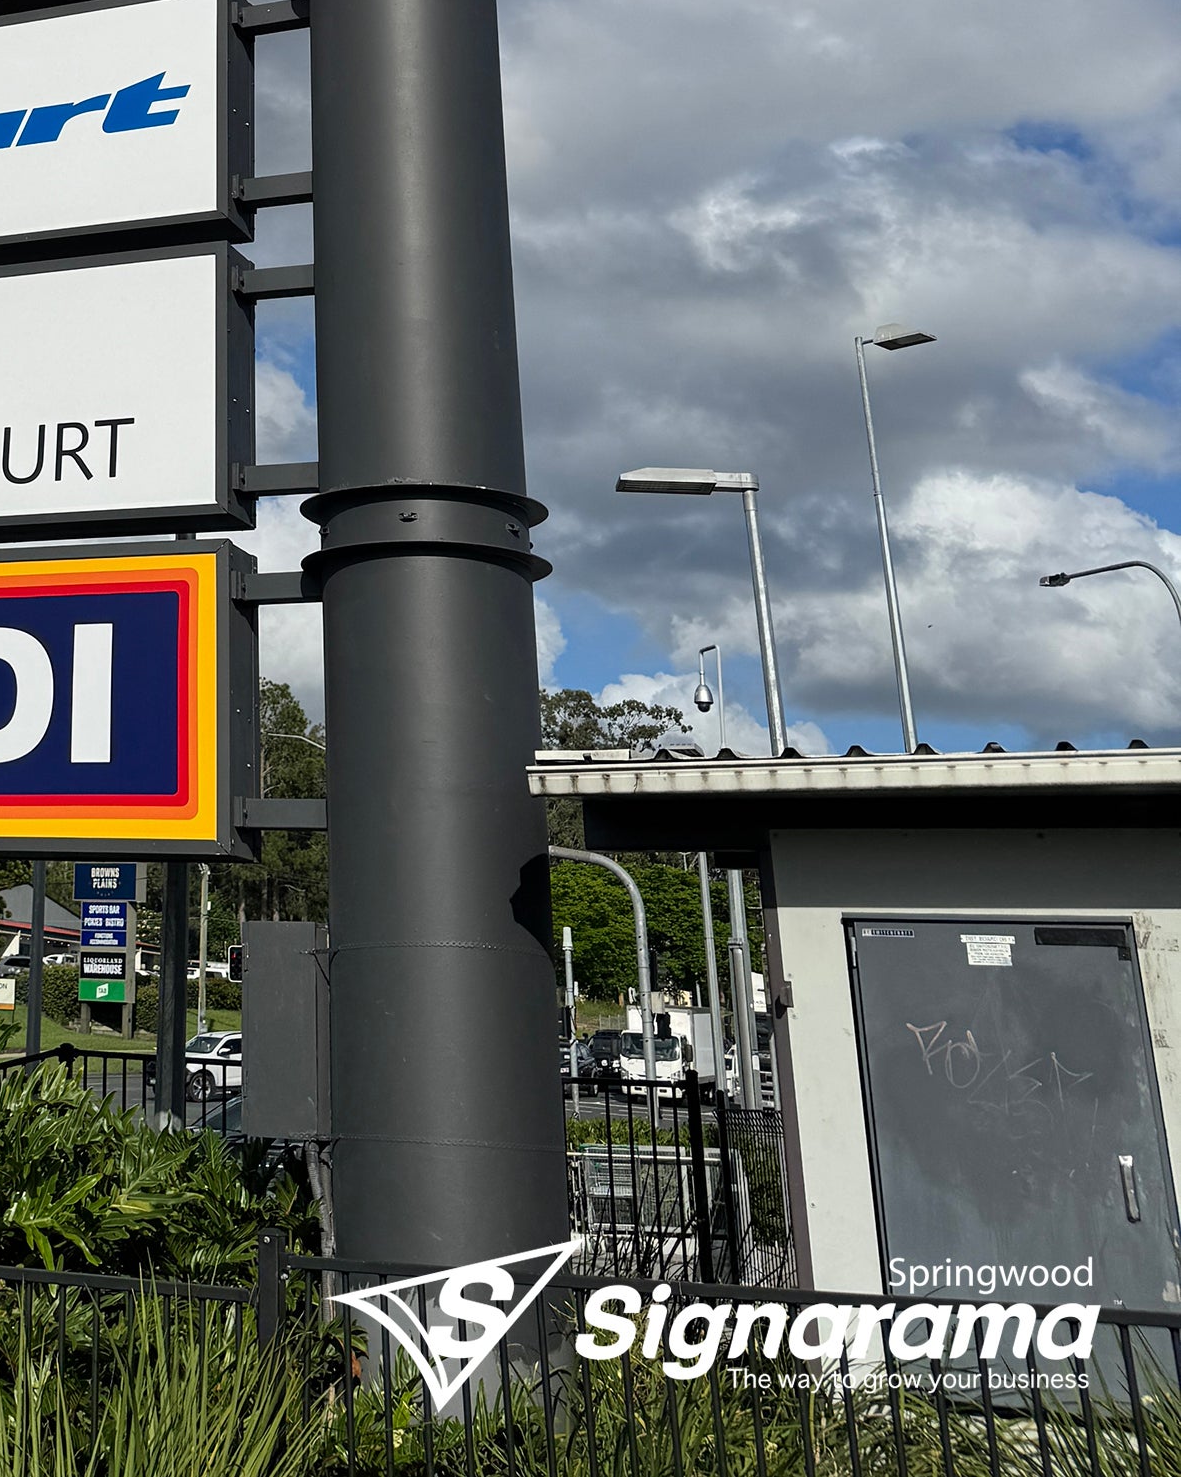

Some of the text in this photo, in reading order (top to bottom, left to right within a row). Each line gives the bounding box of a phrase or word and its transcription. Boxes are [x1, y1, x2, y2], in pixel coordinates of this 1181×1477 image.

[90, 867, 120, 879] BROWNS
[92, 878, 118, 889] PLAINS
[83, 957, 123, 965] LIQUORLAND
[83, 963, 123, 975] WAREHOUSE
